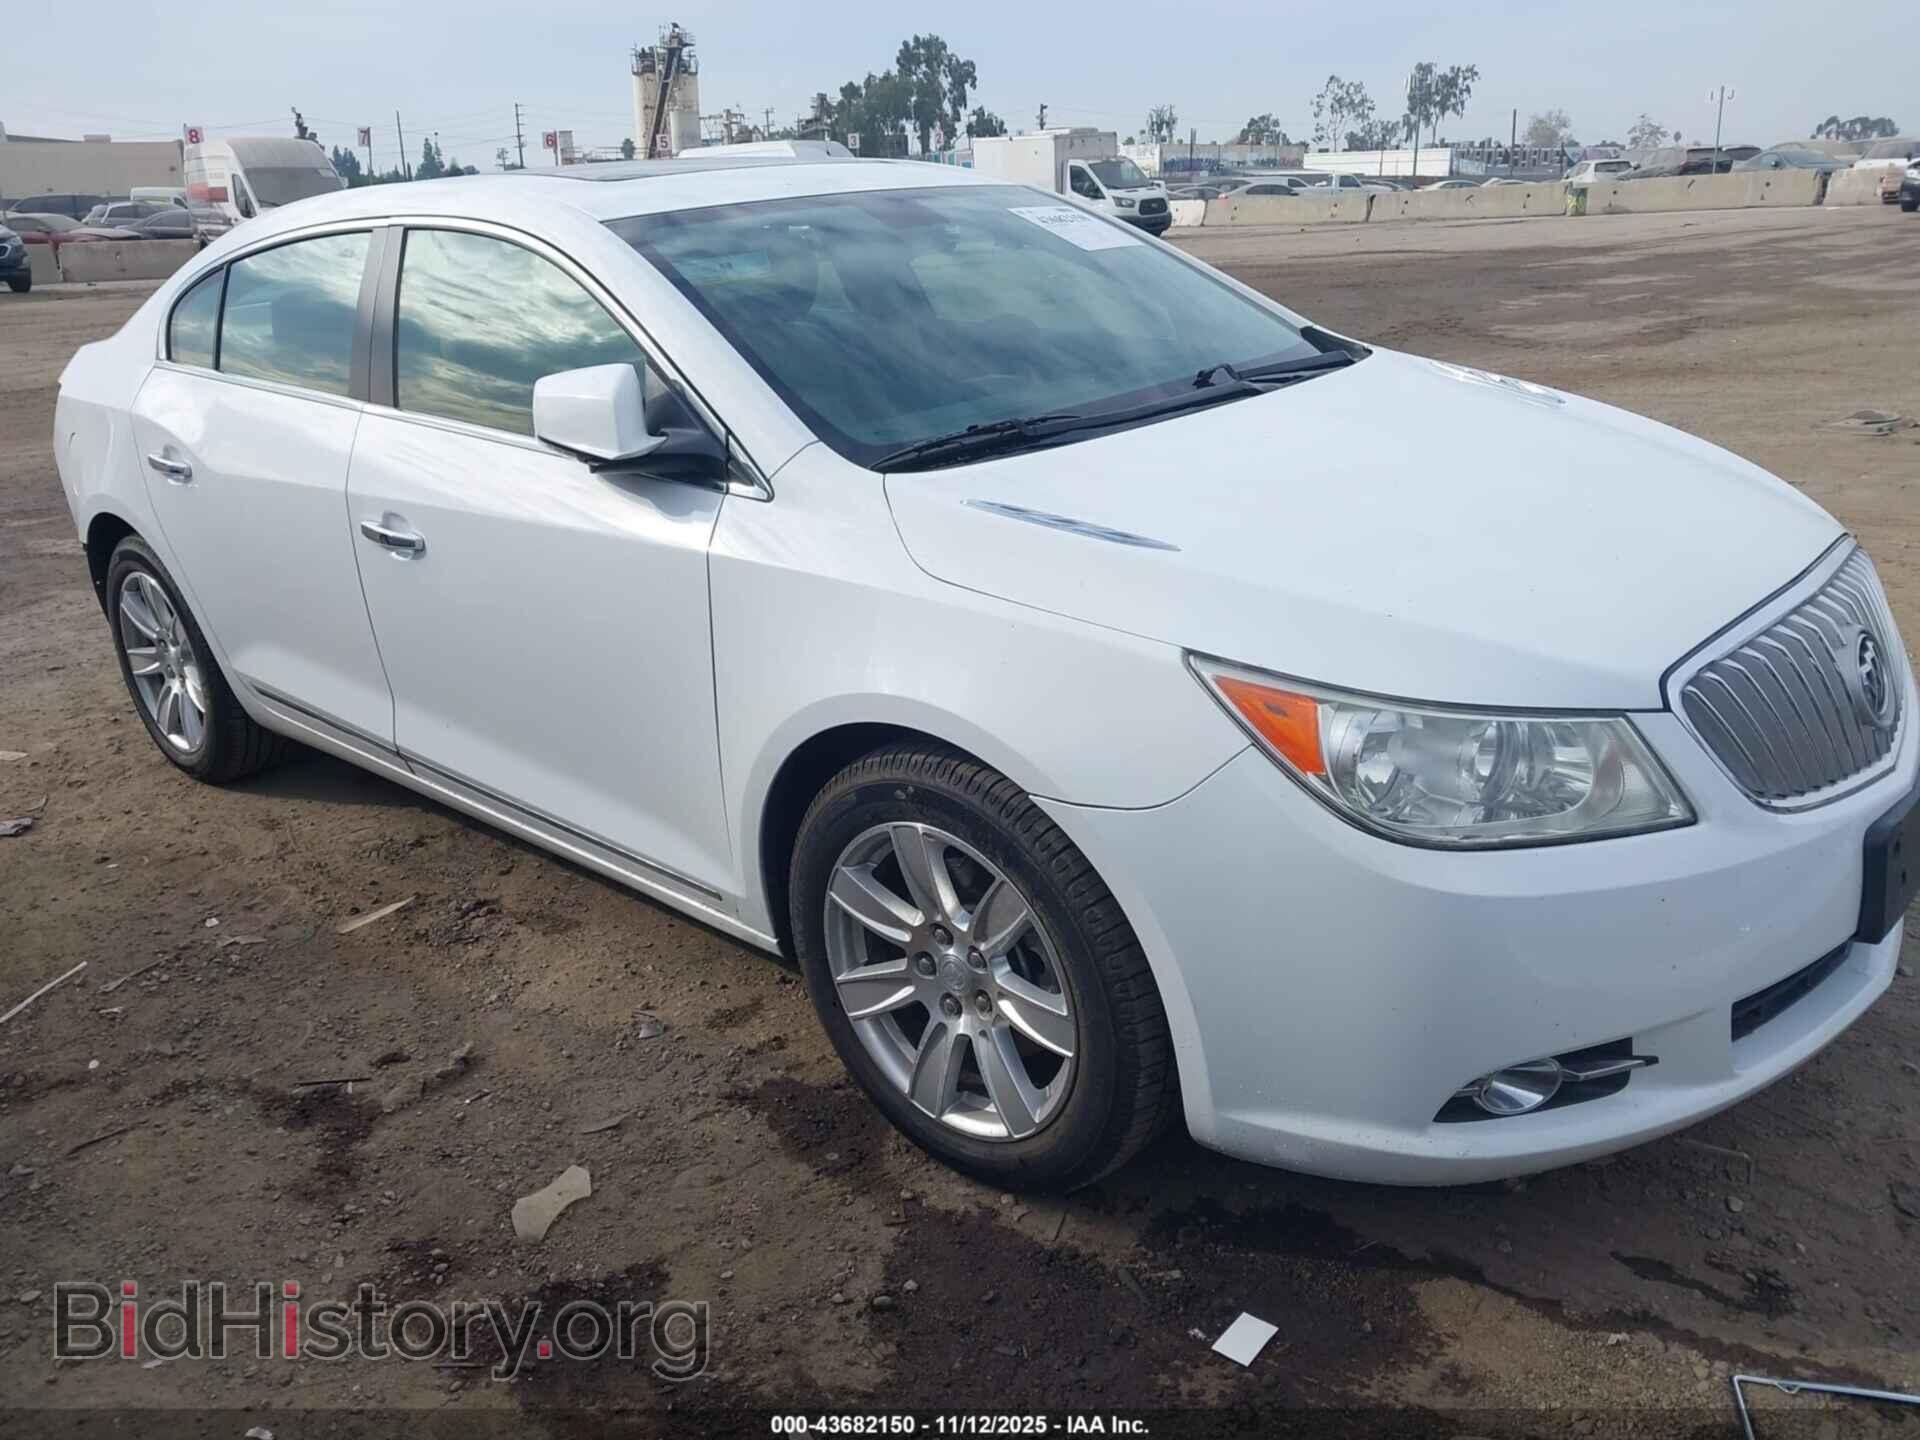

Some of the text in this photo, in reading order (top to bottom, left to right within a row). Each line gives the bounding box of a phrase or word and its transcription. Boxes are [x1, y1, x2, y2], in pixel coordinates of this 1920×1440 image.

[188, 128, 201, 144] 8
[360, 129, 368, 145] 7
[545, 134, 555, 148] 6
[660, 135, 668, 149] 5
